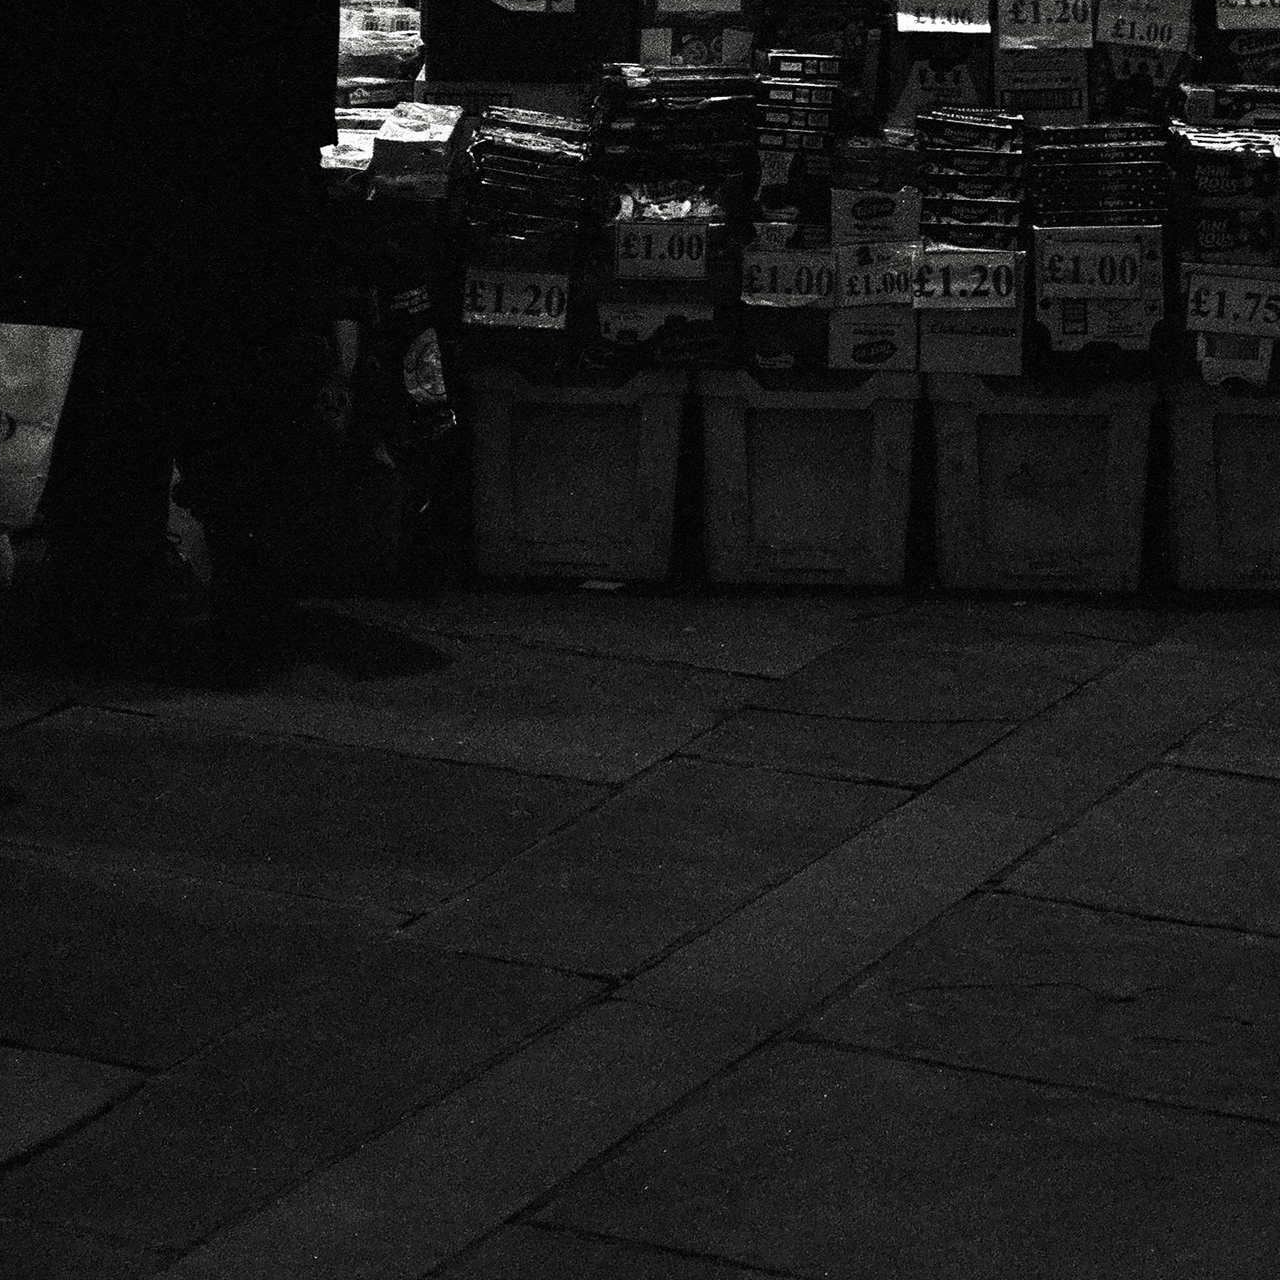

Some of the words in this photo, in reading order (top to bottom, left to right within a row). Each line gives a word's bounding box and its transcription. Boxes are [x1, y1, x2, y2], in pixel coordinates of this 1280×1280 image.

[1008, 0, 1089, 25] £1.20
[1112, 18, 1173, 42] £1.00
[621, 233, 705, 261] £1.00
[744, 264, 835, 297] £1.00
[846, 271, 910, 296] £1.00
[913, 264, 1014, 298] £1.20
[1048, 253, 1138, 286] £1.00
[469, 281, 566, 319] £1.20
